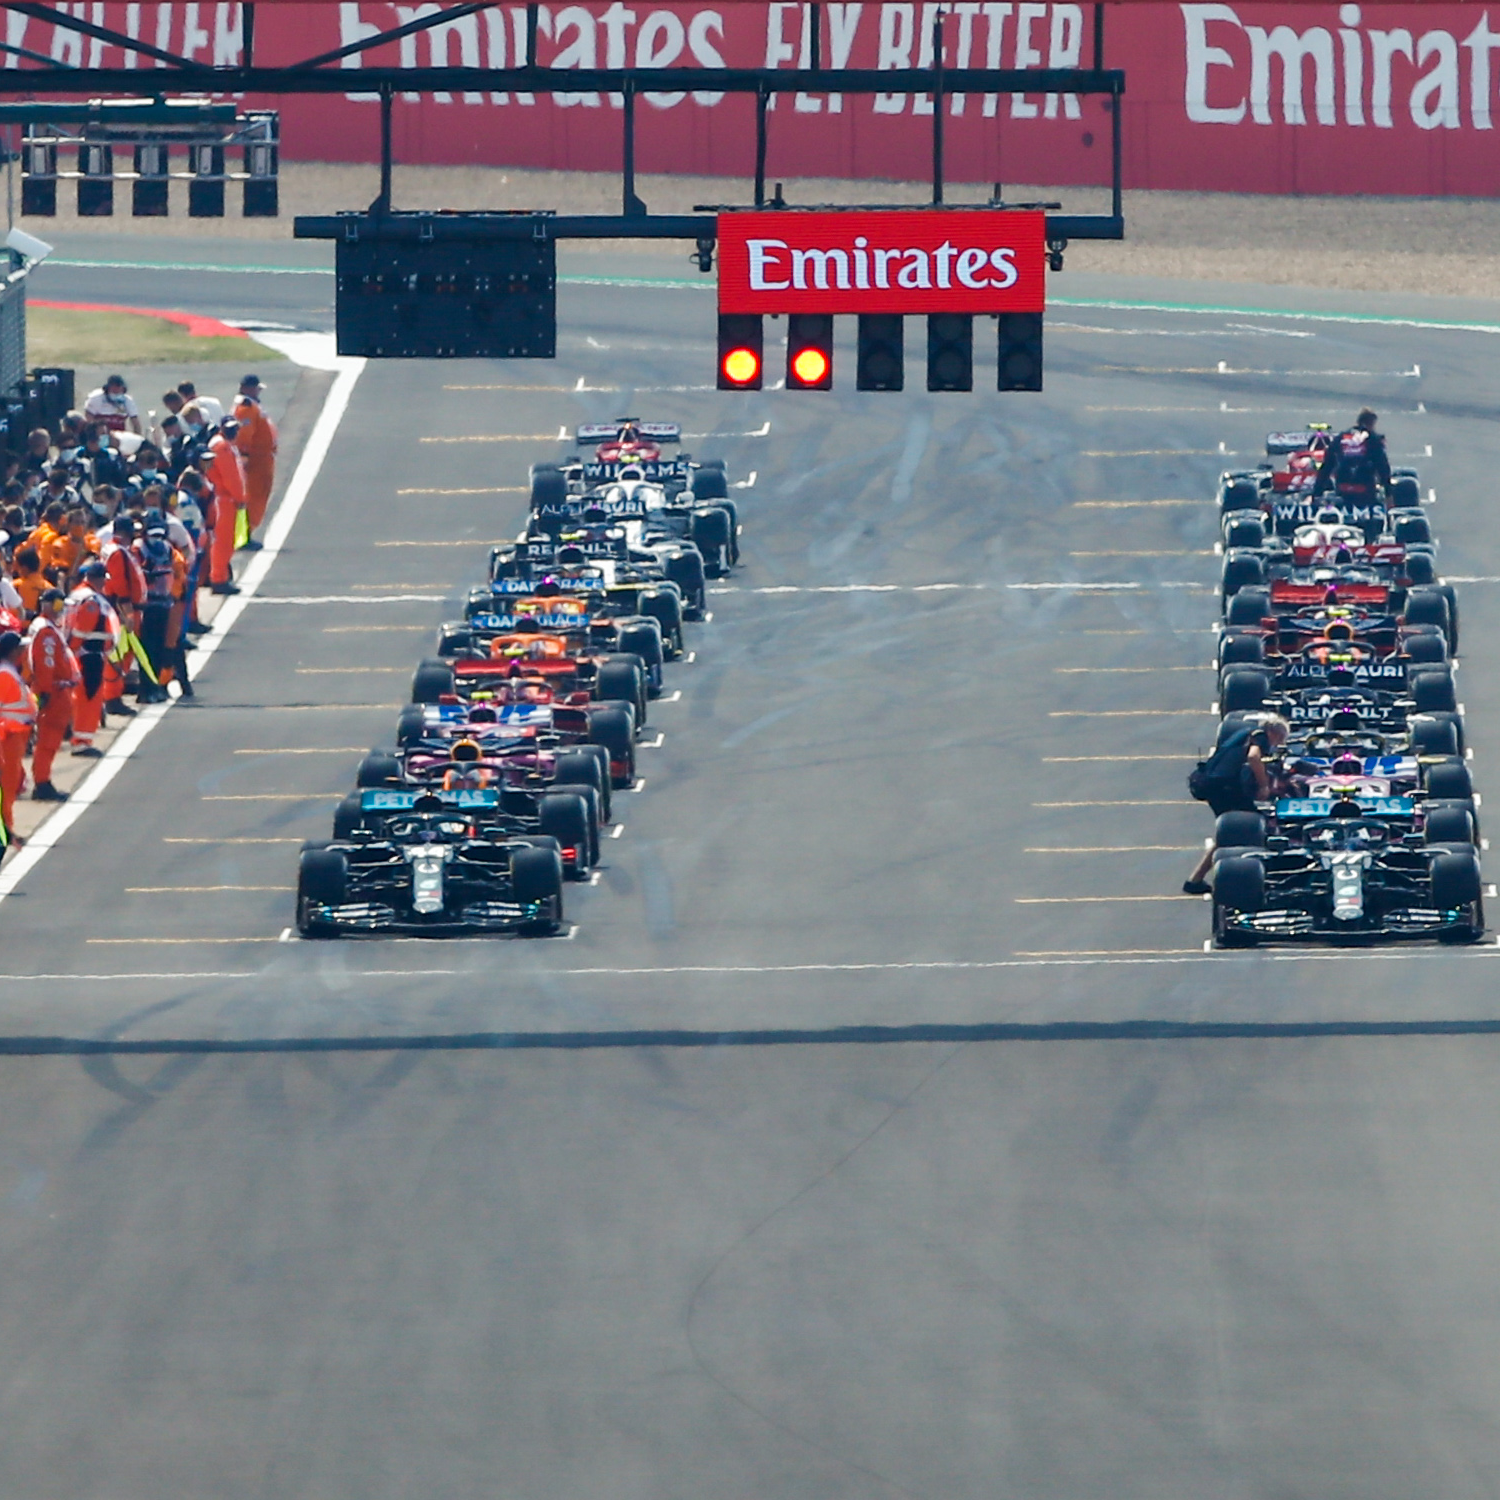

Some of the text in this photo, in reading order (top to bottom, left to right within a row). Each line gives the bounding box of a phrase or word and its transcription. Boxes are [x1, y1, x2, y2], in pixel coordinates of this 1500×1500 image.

[339, 2, 1083, 121] Emirates FLY BETTER
[746, 236, 1018, 290] Emirates
[585, 463, 687, 477] WILAMS
[1277, 505, 1385, 520] WILAMS
[527, 542, 615, 555] RENULT
[1290, 706, 1393, 719] RENULT
[373, 791, 486, 806] PETNAS
[1287, 798, 1403, 813] PETNAS
